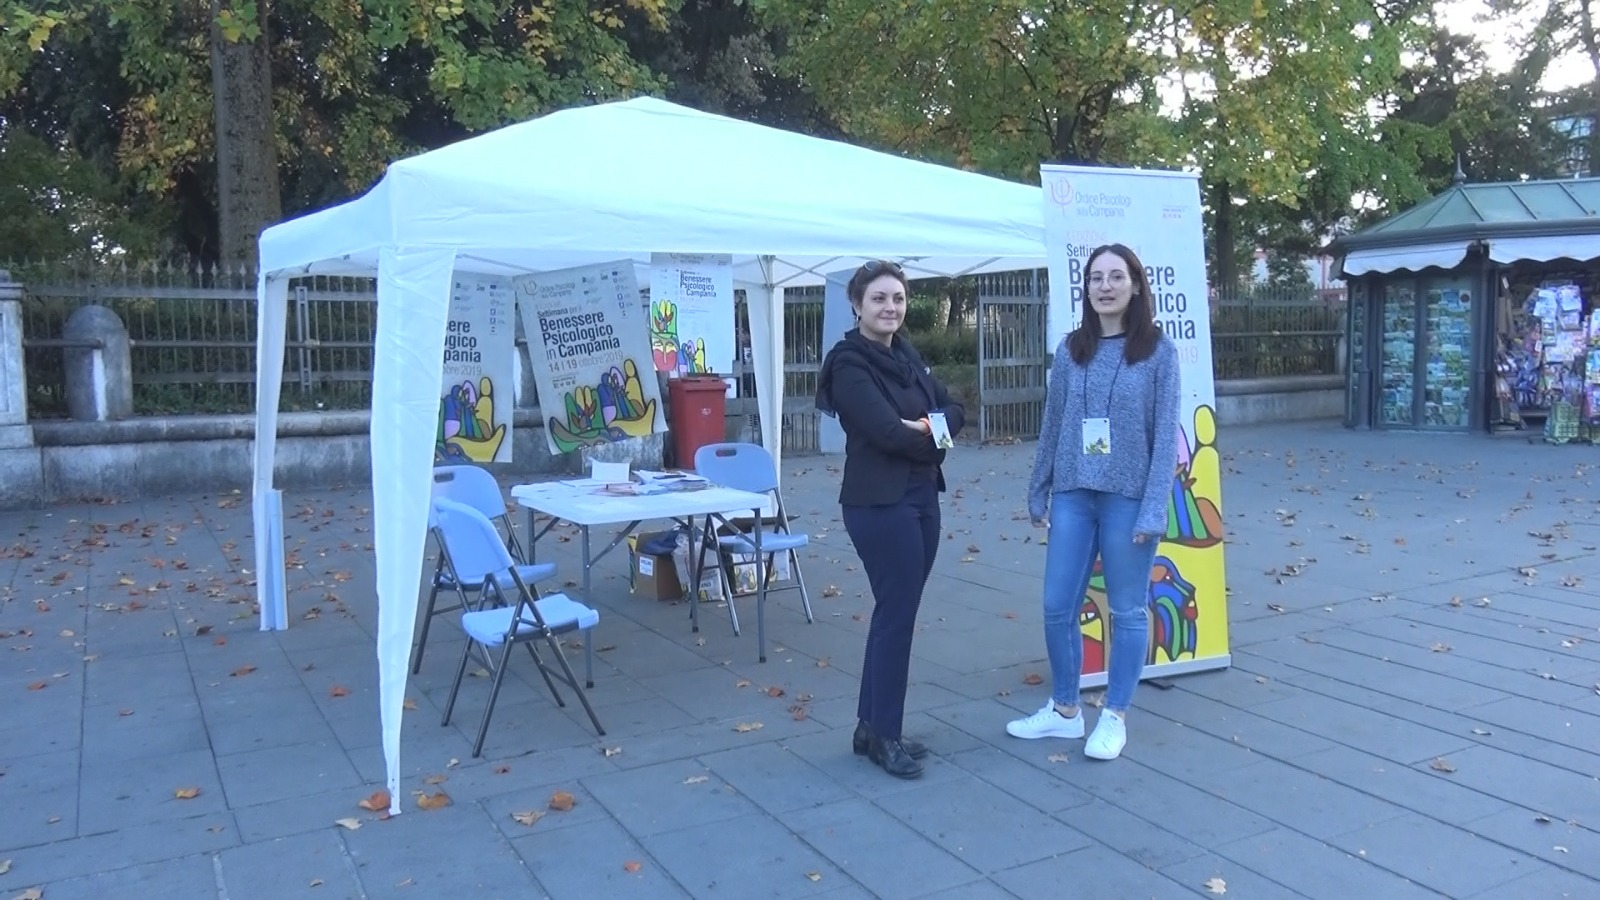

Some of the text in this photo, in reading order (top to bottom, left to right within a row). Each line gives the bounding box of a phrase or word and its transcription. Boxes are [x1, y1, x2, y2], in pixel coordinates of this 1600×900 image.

[680, 273, 712, 284] Benessere
[680, 281, 715, 291] Psicologico
[539, 311, 605, 332] Benessere
[542, 324, 614, 347] Psicologico
[545, 336, 620, 361] in Campania
[549, 362, 560, 373] 14
[566, 359, 578, 371] 19
